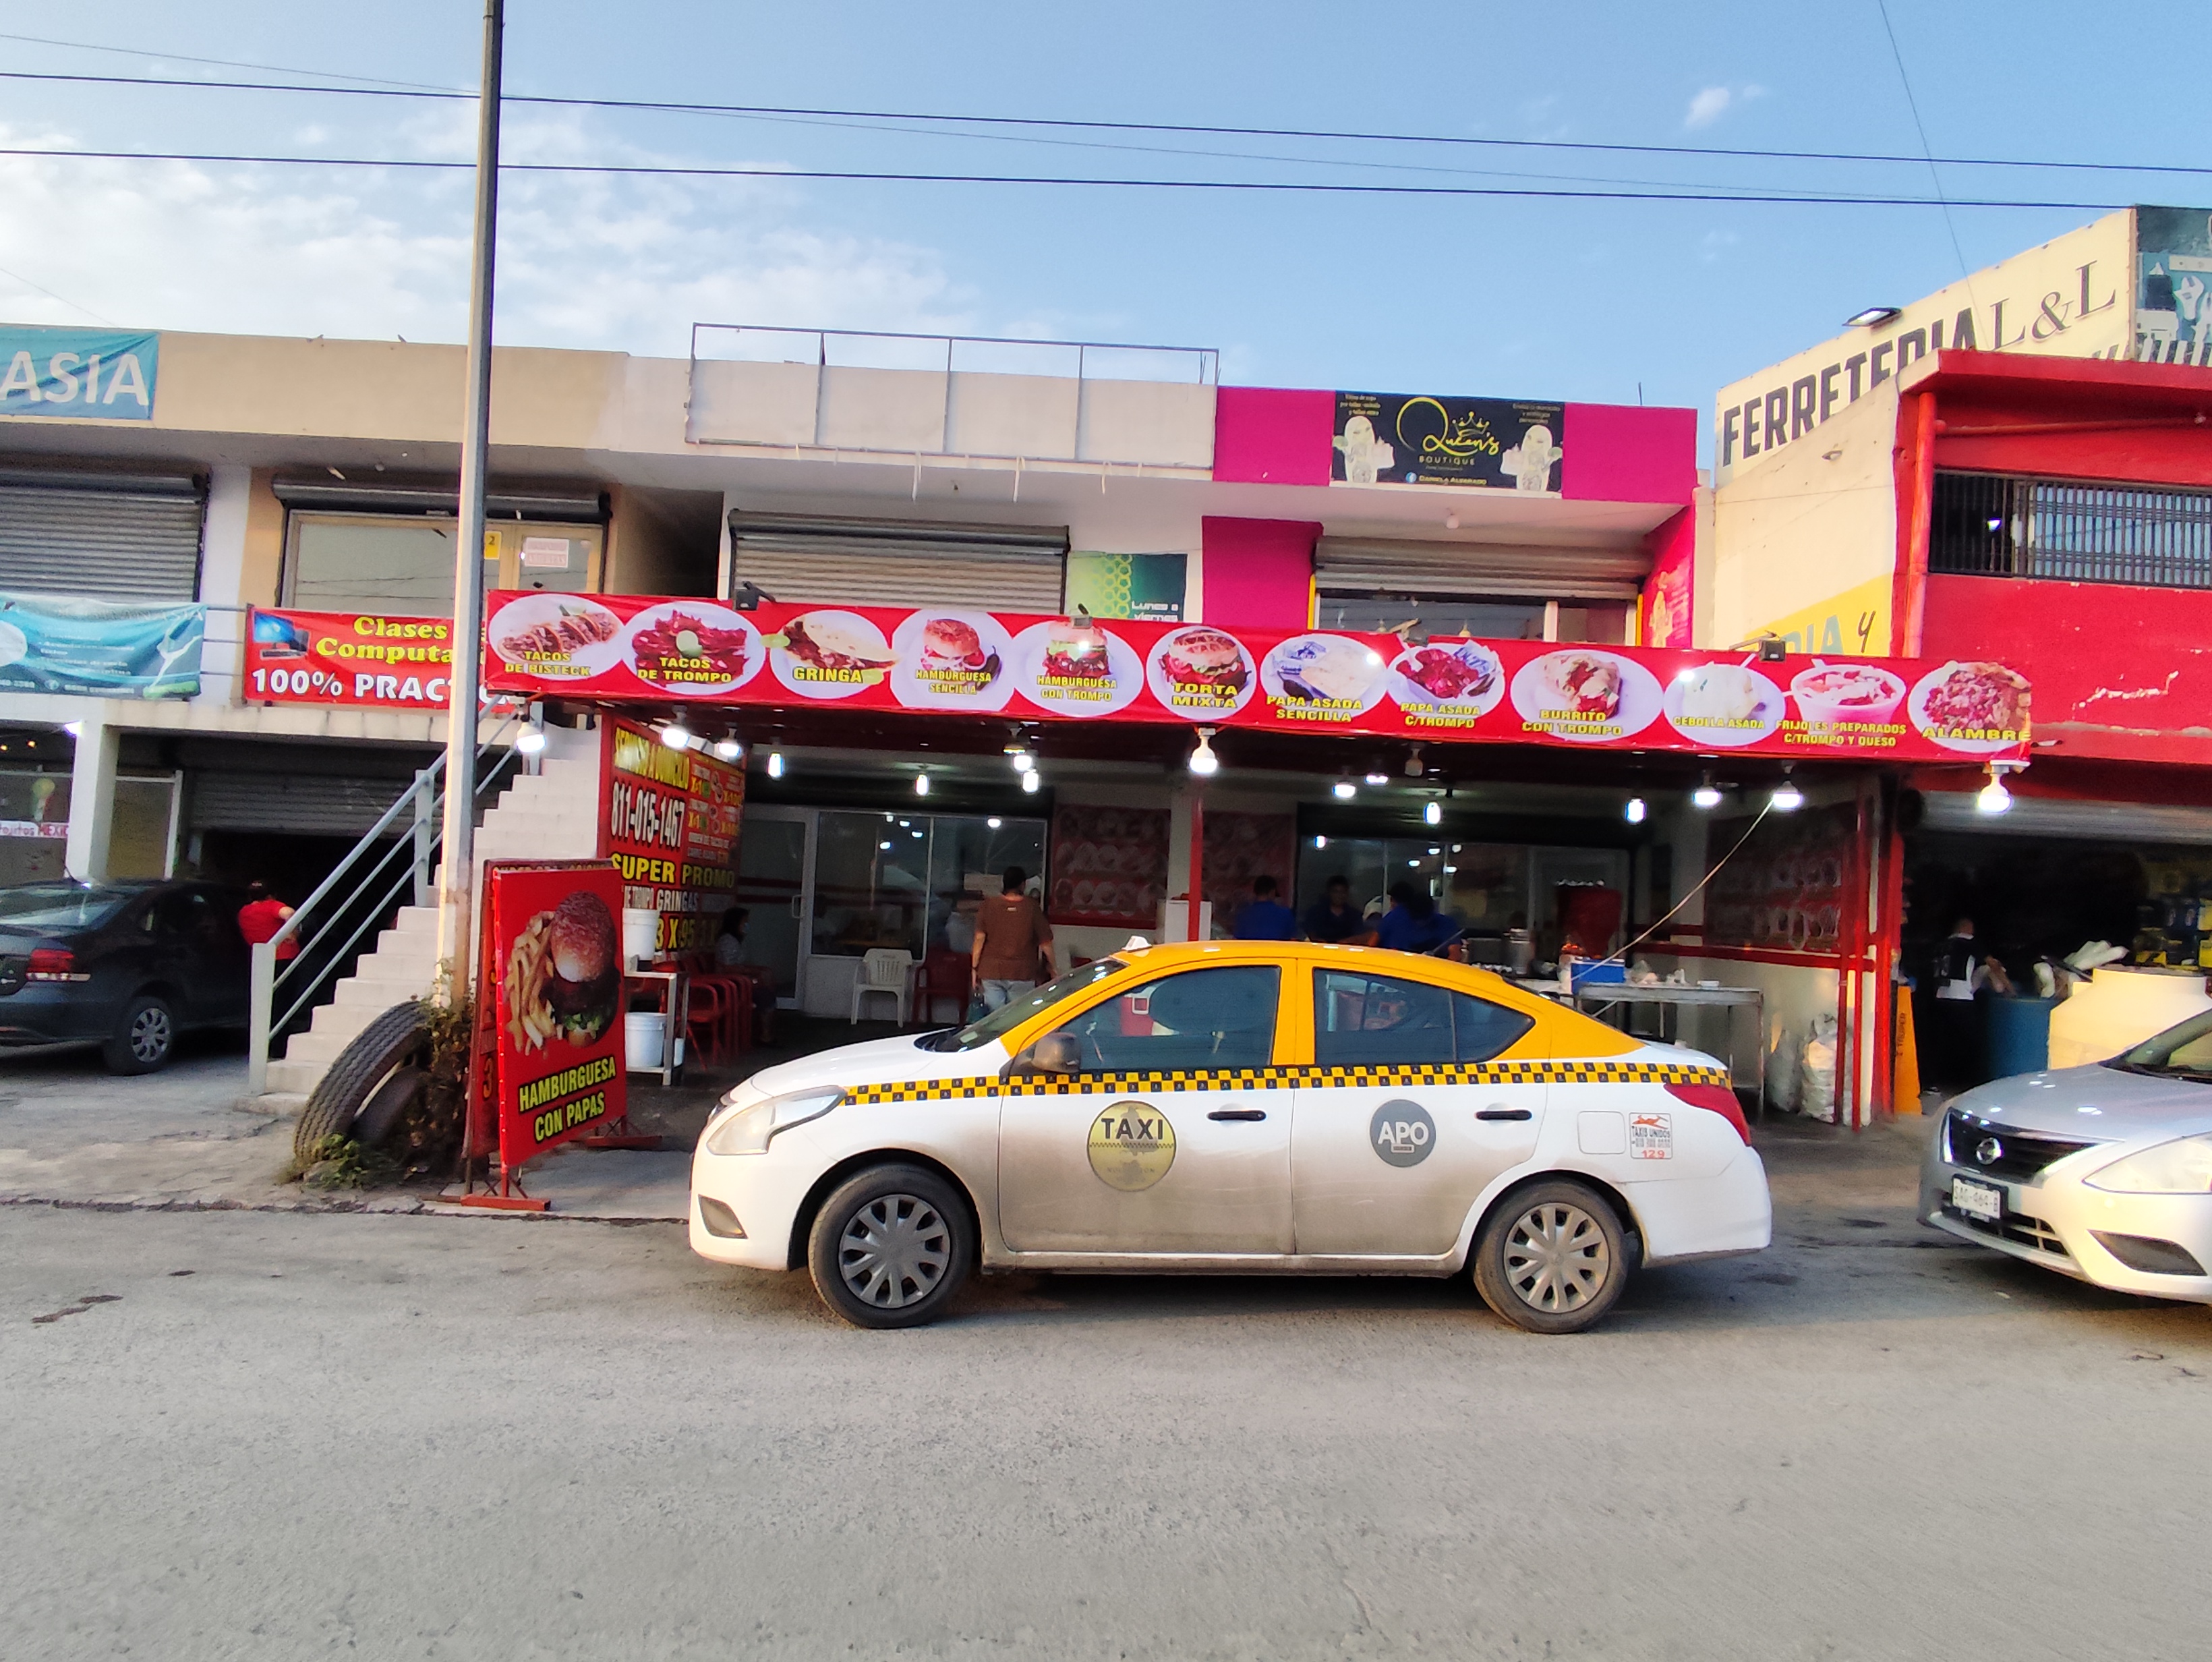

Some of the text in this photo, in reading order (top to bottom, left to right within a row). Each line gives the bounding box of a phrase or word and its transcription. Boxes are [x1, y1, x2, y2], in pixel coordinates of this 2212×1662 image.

[1990, 260, 2116, 350] L&L
[0, 351, 150, 406] ASIA
[1419, 455, 1476, 465] BOUTIQUE
[353, 617, 448, 640] Clases
[316, 637, 472, 665] Computa
[523, 651, 571, 662] TACOS
[504, 663, 591, 676] DE BISTECK
[659, 656, 711, 669] TACOS
[252, 668, 343, 696] 100%
[637, 668, 732, 683] DE TROMPO
[792, 666, 864, 684] GRINGA
[914, 669, 992, 683] HAMBURGUESA
[1036, 675, 1117, 689] HAMBURGUESA
[928, 683, 977, 695] SENCILLA
[1041, 689, 1112, 701] CON TROMPO
[1171, 682, 1239, 696] TORTA
[1171, 695, 1238, 709] MIXTA
[1267, 695, 1363, 710] PAPA ASADA
[1400, 702, 1481, 716] PAPA ASADA
[1276, 708, 1352, 723] SENCILLA
[1404, 715, 1476, 728] C/TROMPO
[1539, 709, 1607, 722] BURRITO
[1672, 716, 1765, 730] CEBOLLA ASADA
[1521, 721, 1623, 736] CON TROMPO
[1776, 720, 1907, 735] FRIJOLES PREPARADOS
[1921, 726, 2032, 742] ALAMBRE
[1783, 733, 1896, 747] C/TROMPO Y QUESO
[611, 780, 685, 848] 811-015-1467
[611, 853, 675, 884] SUPER
[681, 864, 735, 888] PROMO
[656, 889, 699, 912] GRINGAS
[519, 1056, 616, 1113] HAMBURGUESA
[534, 1091, 606, 1142] CON PAPAS
[1101, 1117, 1163, 1141] TAXI
[1377, 1120, 1430, 1145] APO
[1641, 1149, 1665, 1158] 129
